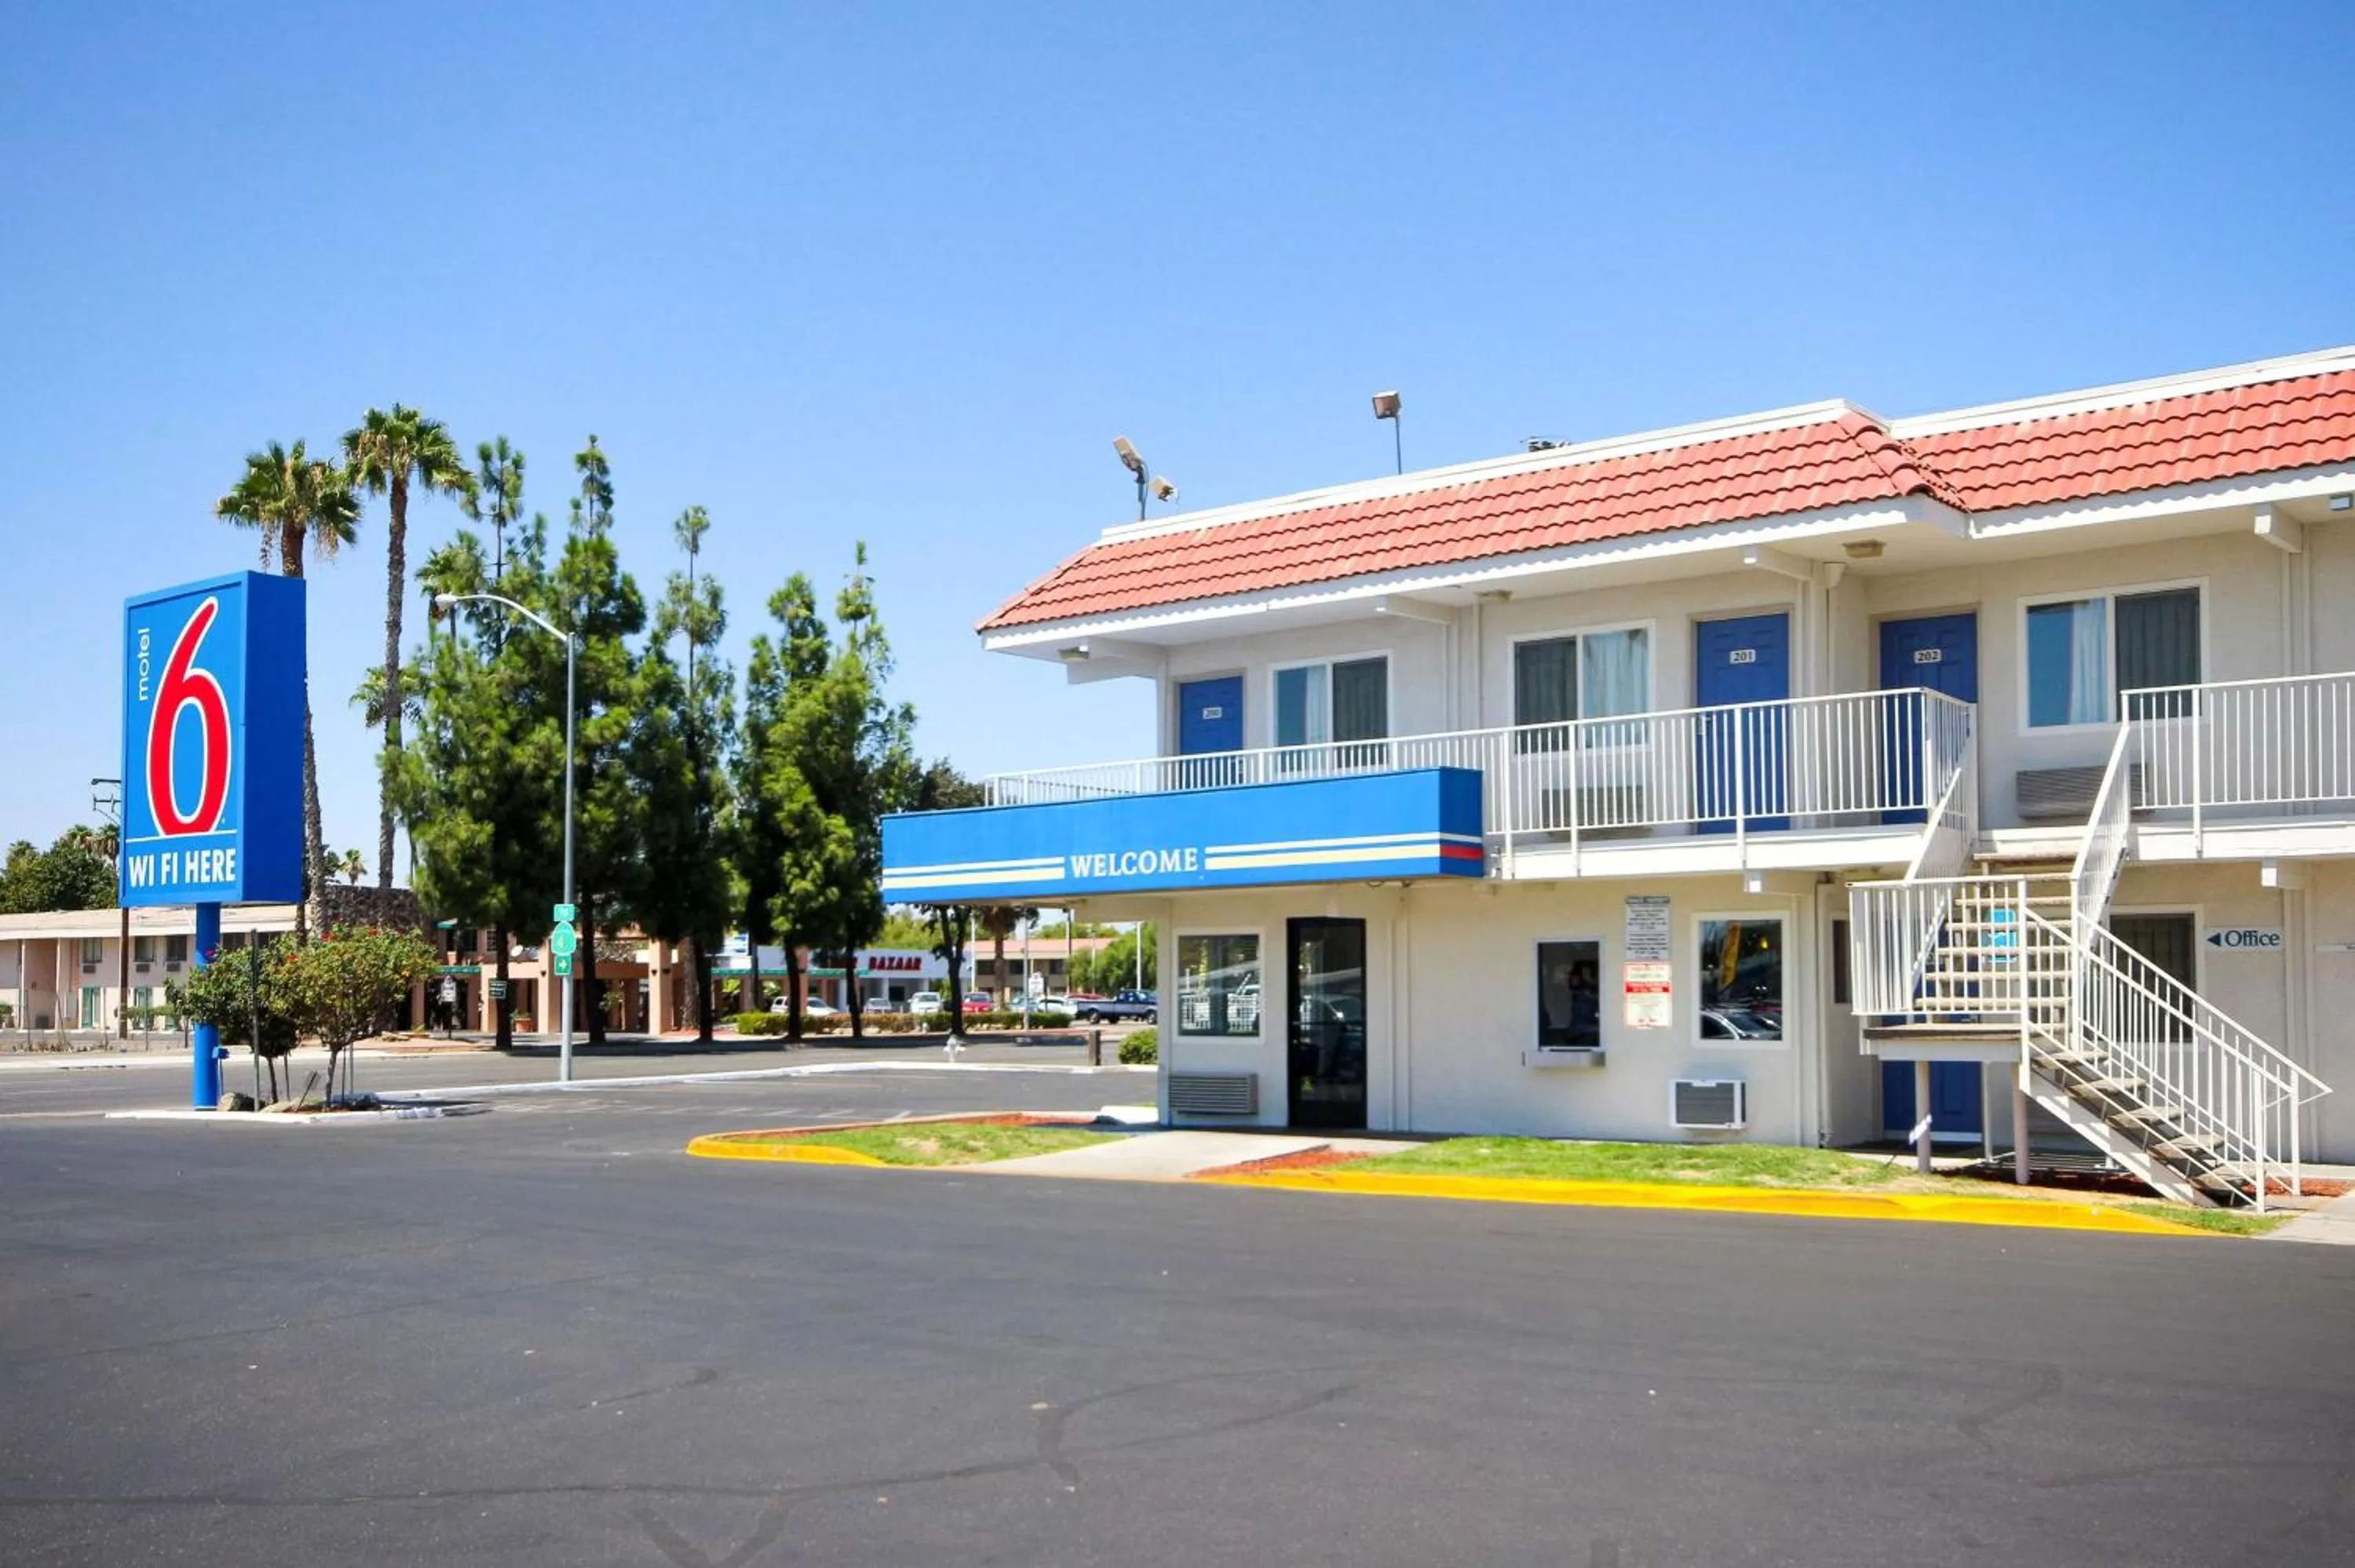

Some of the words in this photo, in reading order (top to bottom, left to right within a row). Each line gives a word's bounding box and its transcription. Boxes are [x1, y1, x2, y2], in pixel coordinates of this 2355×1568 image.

[137, 628, 151, 702] motel
[1732, 651, 1753, 662] 201
[1917, 651, 1938, 662] 202
[146, 596, 232, 837] 6
[128, 853, 155, 888] WI
[161, 851, 179, 885] FI
[184, 848, 236, 884] HERE
[1069, 847, 1199, 879] WELCOME
[2224, 929, 2280, 947] Office
[868, 955, 922, 971] BAZAAR
